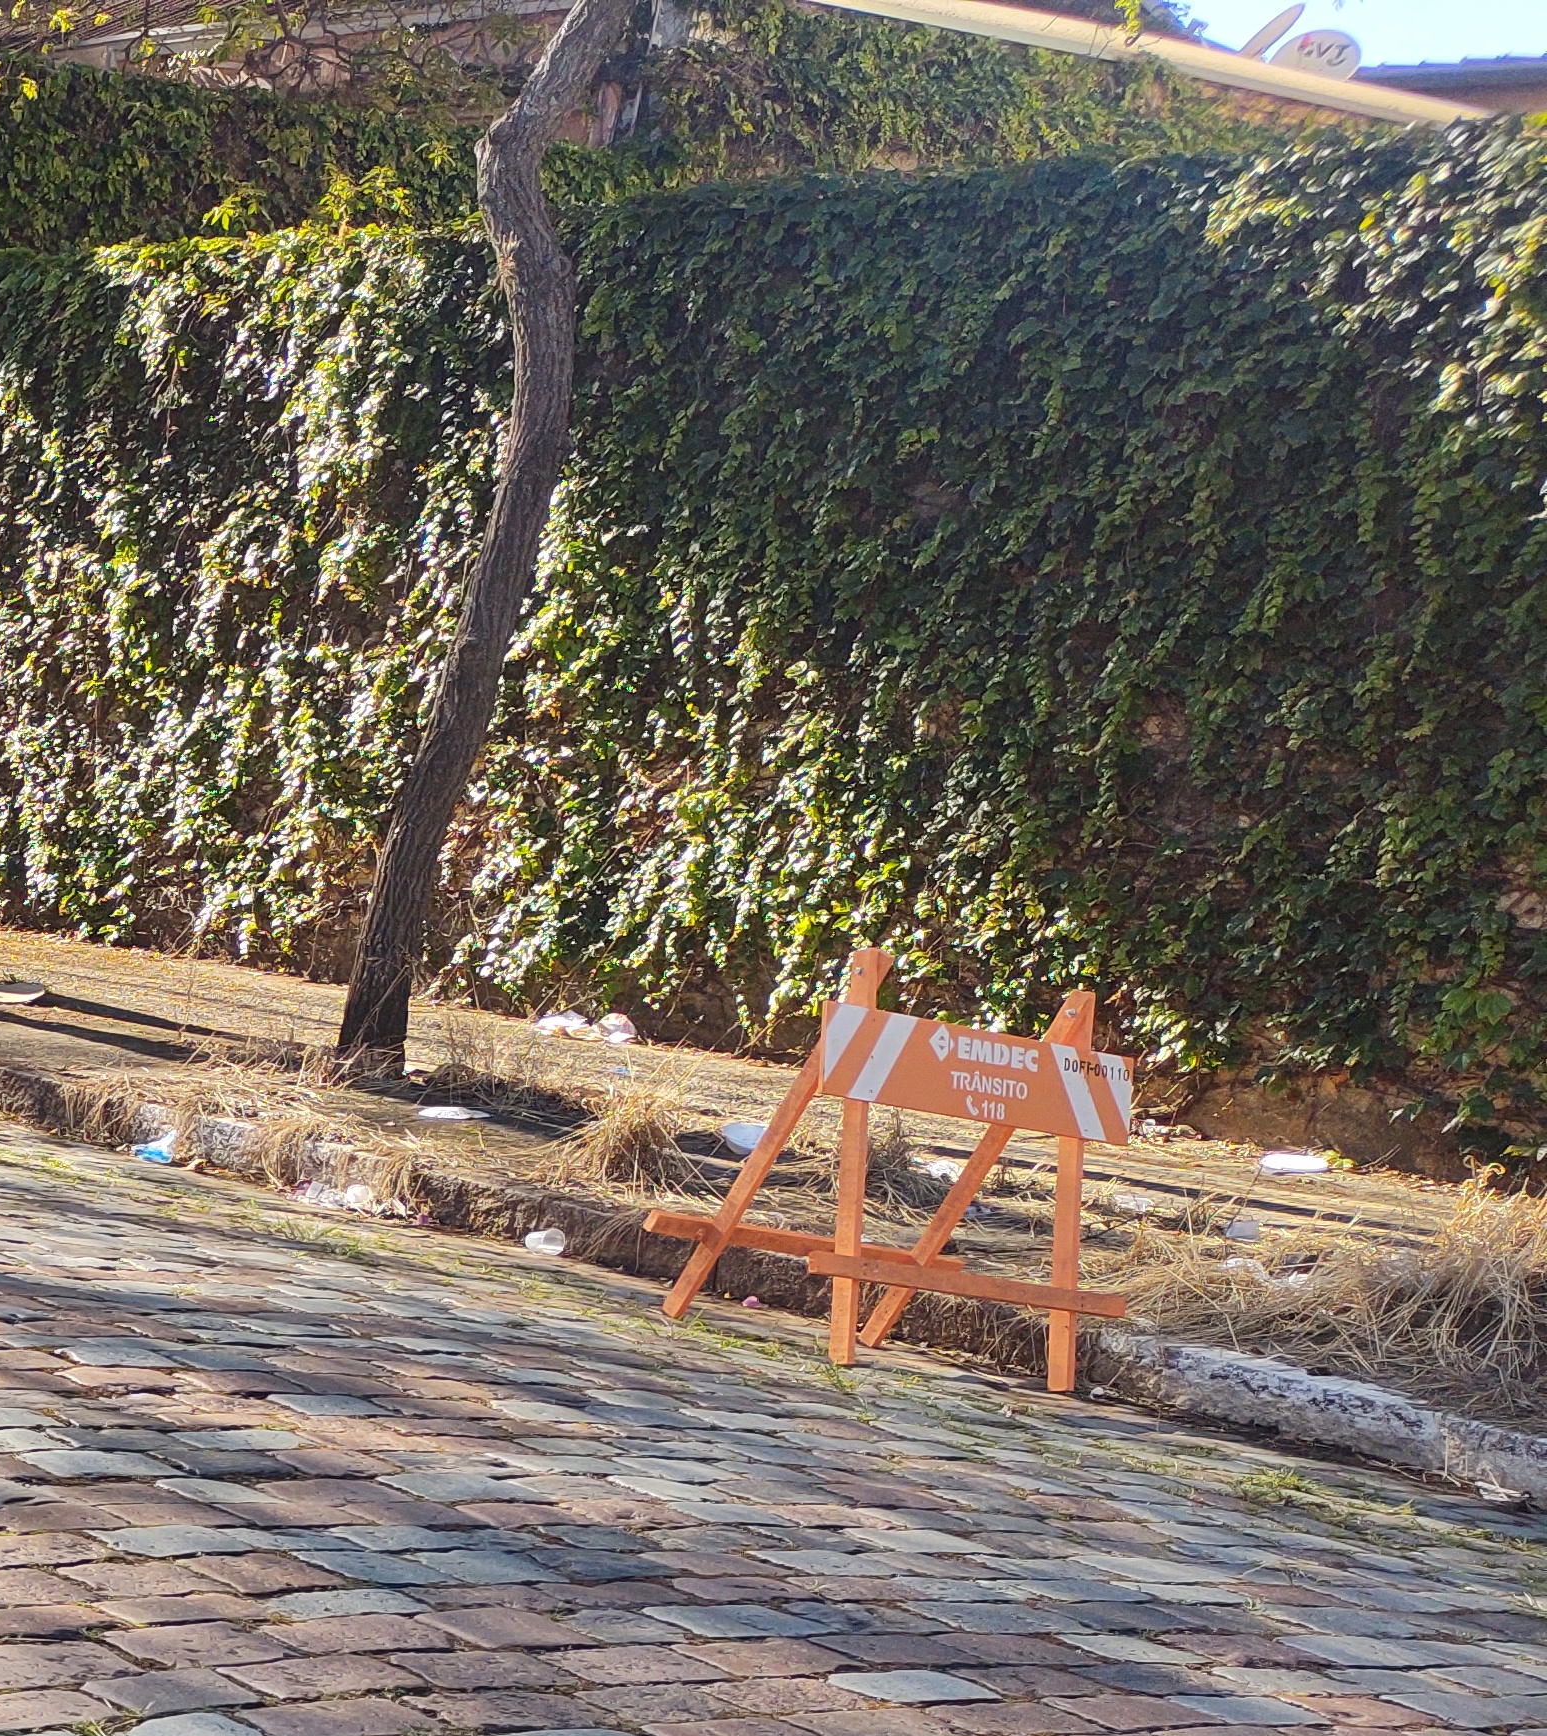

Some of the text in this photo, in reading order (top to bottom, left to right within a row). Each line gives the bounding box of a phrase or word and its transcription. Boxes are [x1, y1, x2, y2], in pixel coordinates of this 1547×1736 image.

[958, 1036, 1039, 1073] EMDEC
[1063, 1057, 1130, 1082] DOFI-00110
[950, 1070, 1028, 1100] TRÂNSITO
[981, 1100, 1006, 1120] 118
